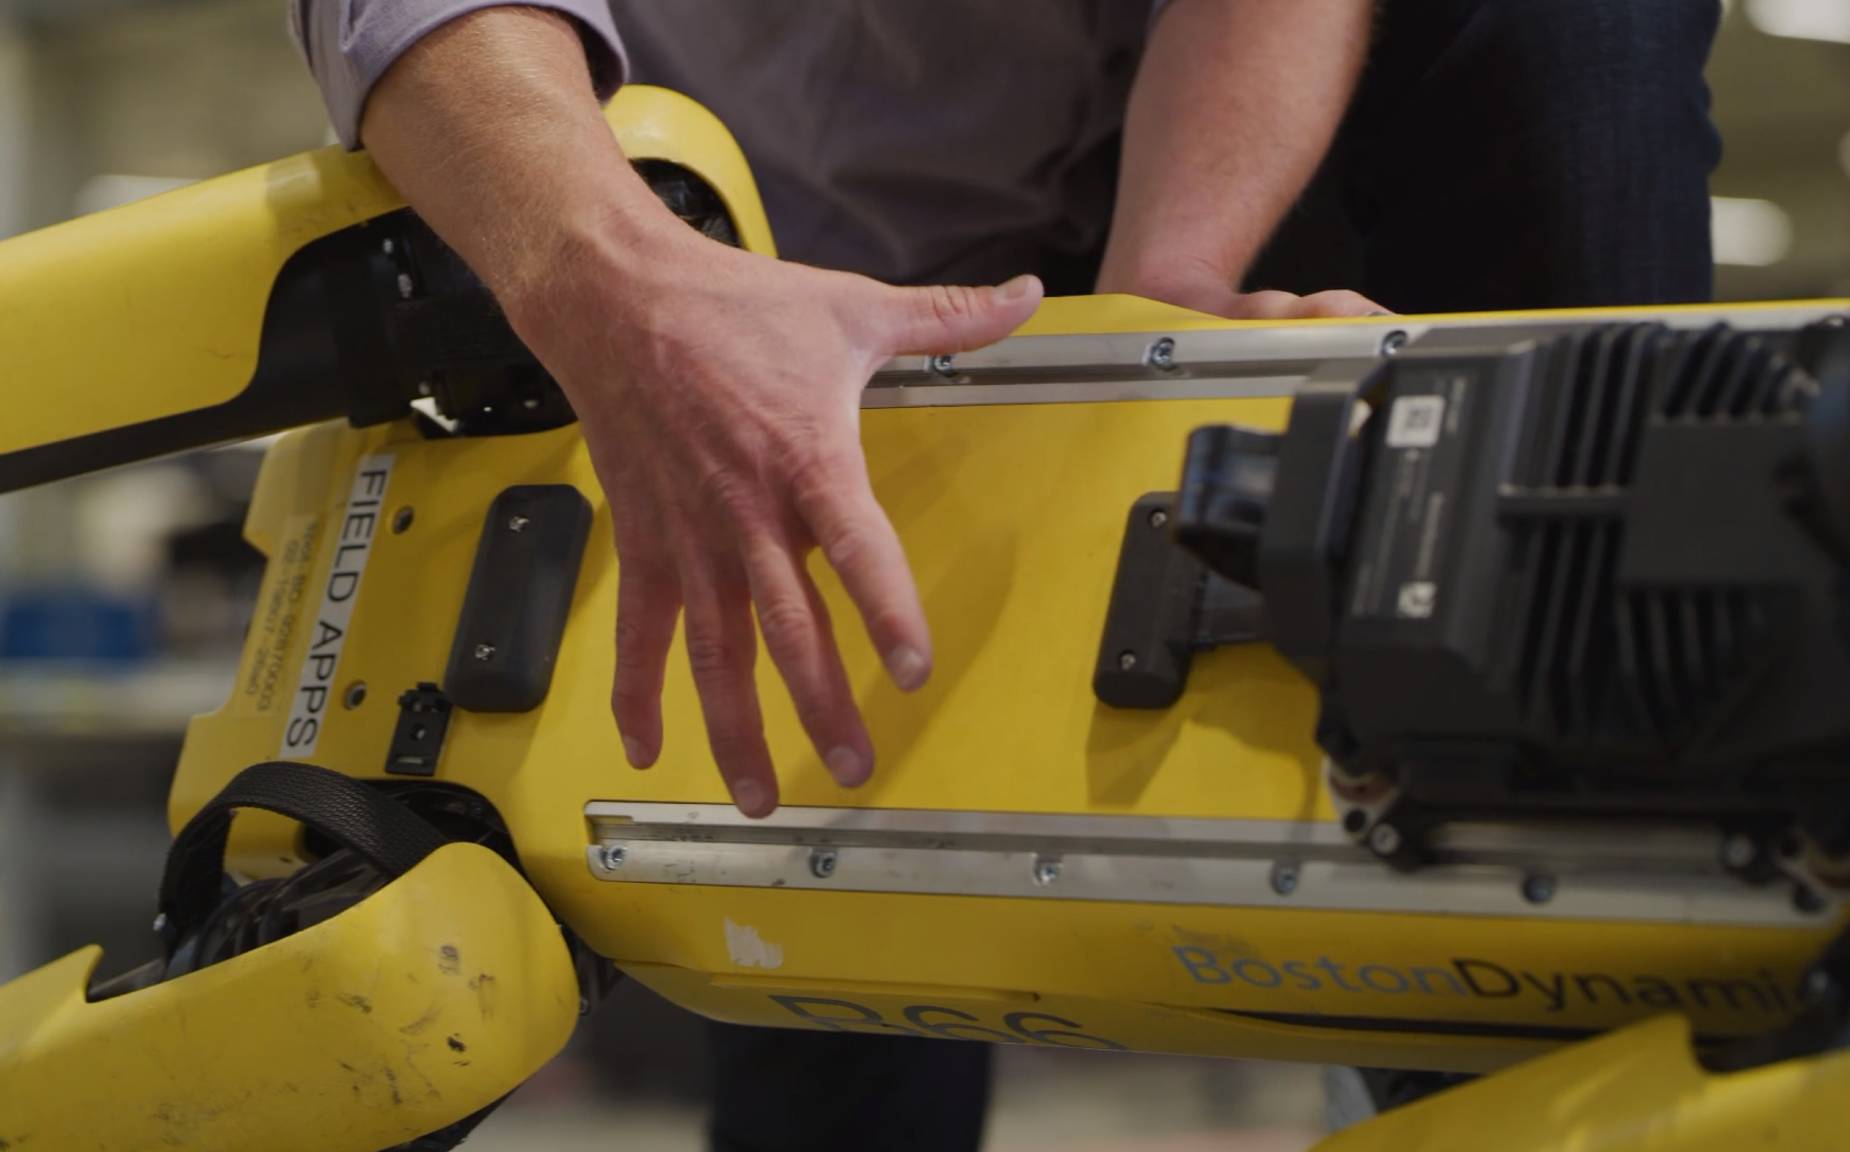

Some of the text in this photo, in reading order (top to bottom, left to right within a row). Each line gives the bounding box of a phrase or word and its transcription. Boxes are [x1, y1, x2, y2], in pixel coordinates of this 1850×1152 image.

[286, 469, 386, 748] FIELD APPS
[1173, 944, 1797, 1012] BostonDynami
